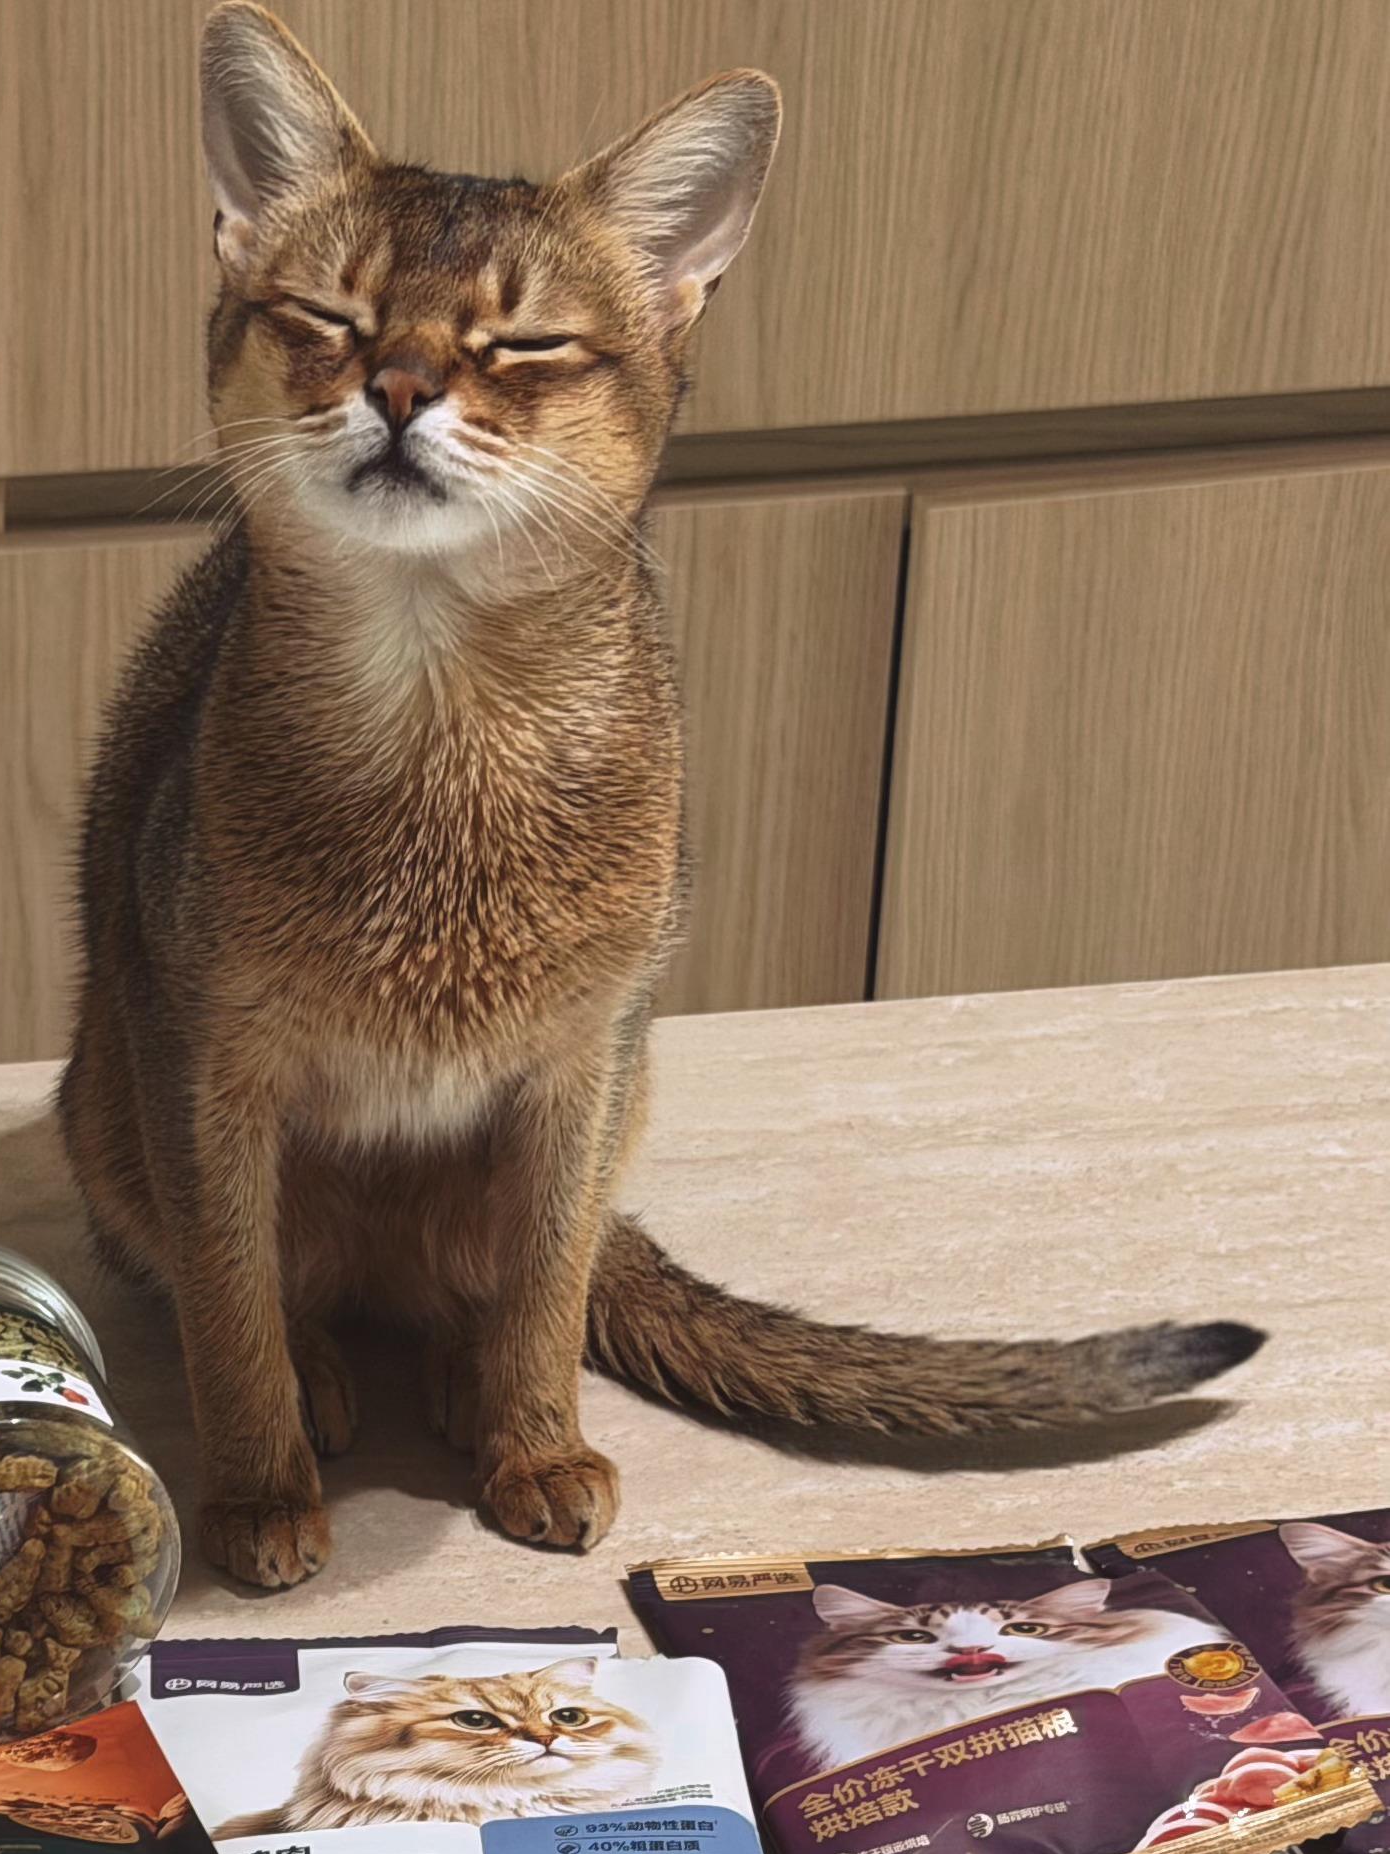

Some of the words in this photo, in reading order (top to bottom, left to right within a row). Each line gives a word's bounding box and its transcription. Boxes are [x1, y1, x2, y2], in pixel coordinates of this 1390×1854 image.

[700, 1567, 802, 1593] 网易严选
[798, 1708, 1078, 1820] 全价冻干双拼猫粮
[809, 1789, 920, 1843] 烘焙款
